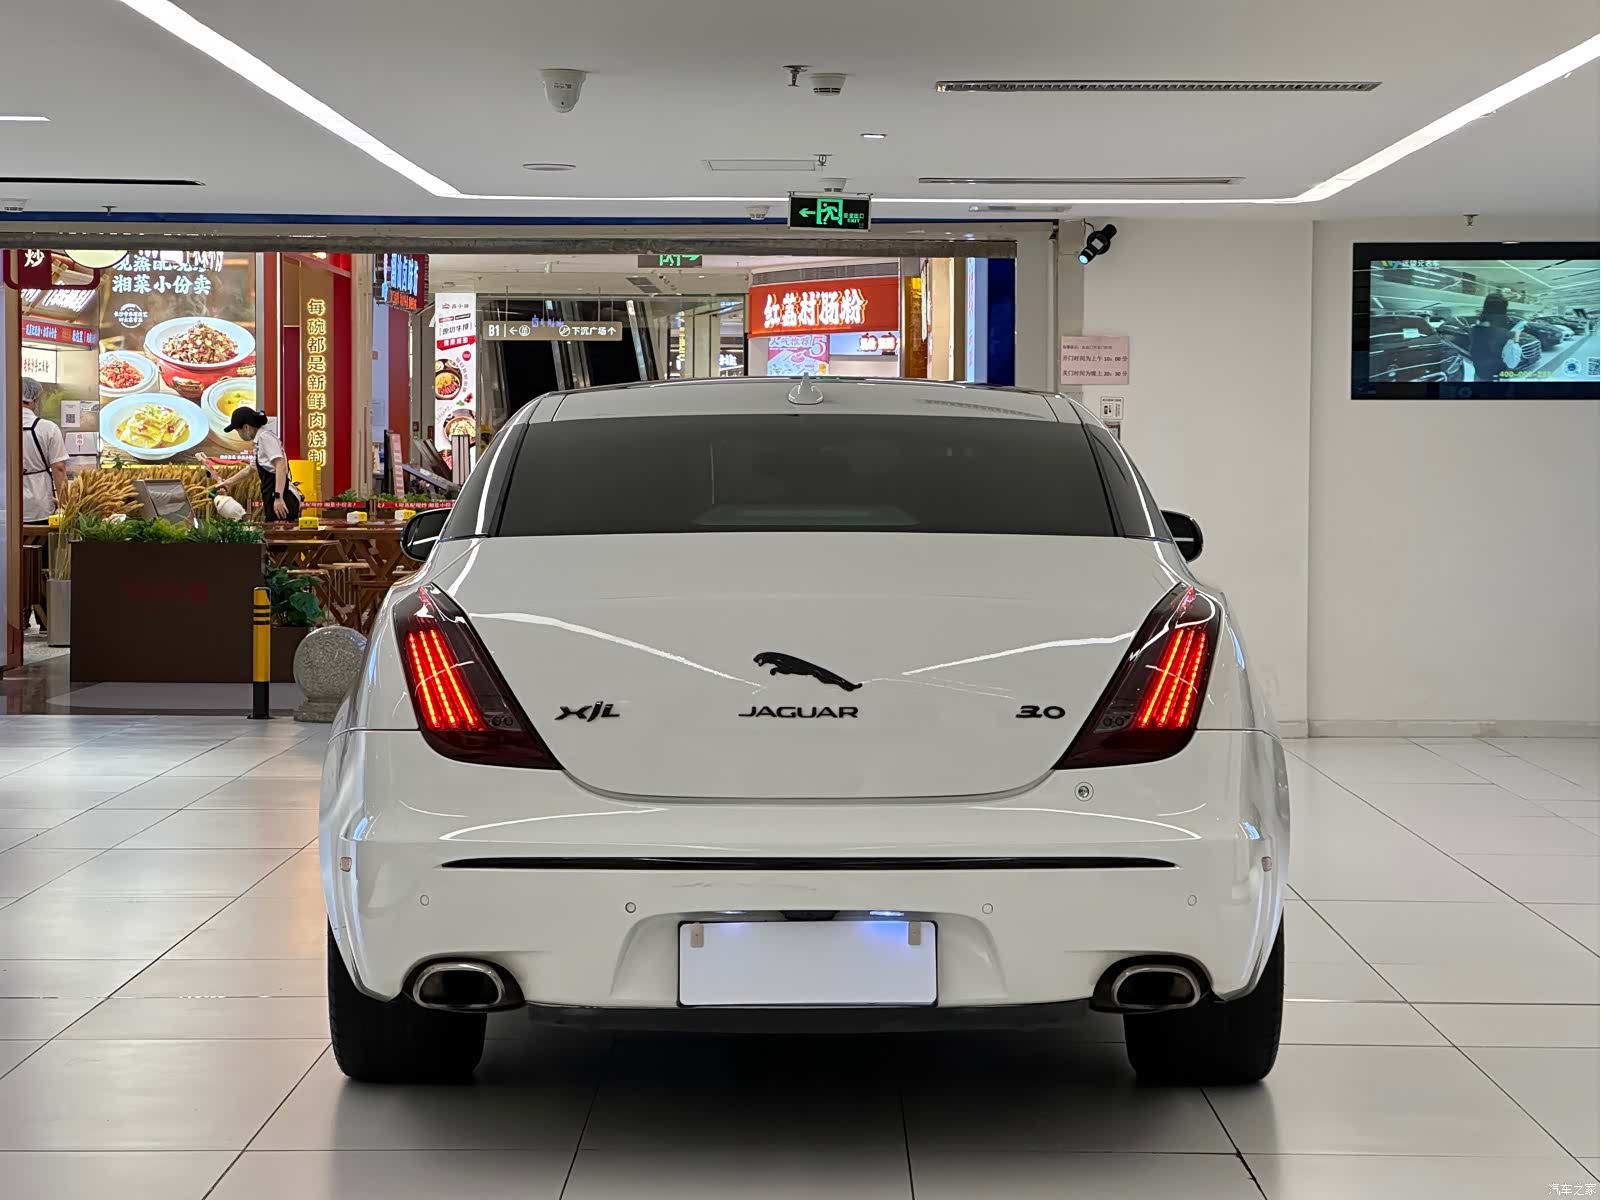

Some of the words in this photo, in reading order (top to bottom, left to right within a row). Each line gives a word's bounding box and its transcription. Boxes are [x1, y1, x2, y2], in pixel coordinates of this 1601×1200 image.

[112, 274, 211, 295] 湘菜小份卖
[764, 288, 866, 328] 红荔村肠粉
[488, 325, 502, 337] B1
[572, 326, 607, 336] 下沉广场
[307, 299, 326, 467] 每碗都是新鲜肉烧制
[738, 706, 859, 718] JAGUAR
